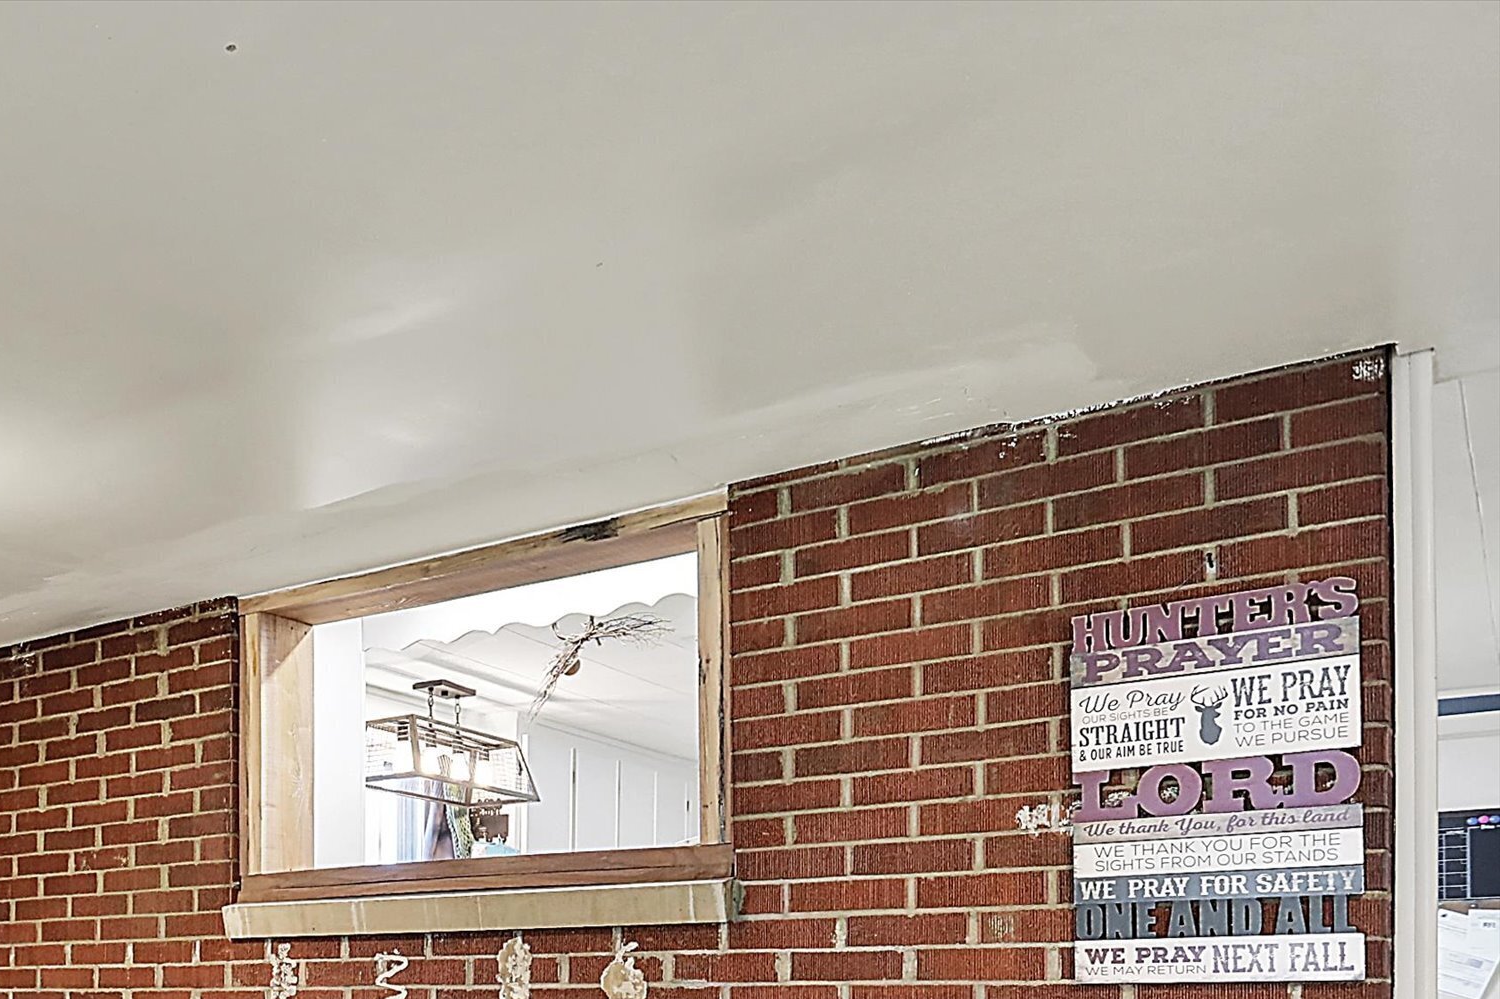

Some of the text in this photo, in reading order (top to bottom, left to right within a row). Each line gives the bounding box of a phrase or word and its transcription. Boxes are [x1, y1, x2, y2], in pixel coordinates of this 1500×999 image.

[1081, 623, 1344, 684] PRAYER
[1231, 664, 1351, 707] WE PRAY
[1079, 690, 1185, 713] We Pray
[1234, 698, 1349, 720] FOR NO PAIN
[1082, 707, 1168, 724] OUR SIGHTS BE
[1233, 712, 1349, 733] TO THE GAME
[1079, 717, 1185, 747] STRAIGHT
[1235, 726, 1348, 747] WE PURSUE
[1079, 740, 1184, 762] & OUR AIM BE TRUE
[1071, 750, 1361, 822] LORD
[1083, 809, 1349, 836] We thank You, for this land
[1094, 833, 1340, 858] WE THANK YOU FOR THE
[1095, 848, 1339, 871] SIGHTS FROM OUR STANDS
[1080, 870, 1355, 900] WE PRAY FOR SAFETY
[1076, 895, 1357, 940] ONE AND ALL
[1085, 946, 1206, 964] WE PRAY
[1212, 942, 1354, 973] NEXT FALL
[1085, 964, 1206, 976] WE MAY RETURN
